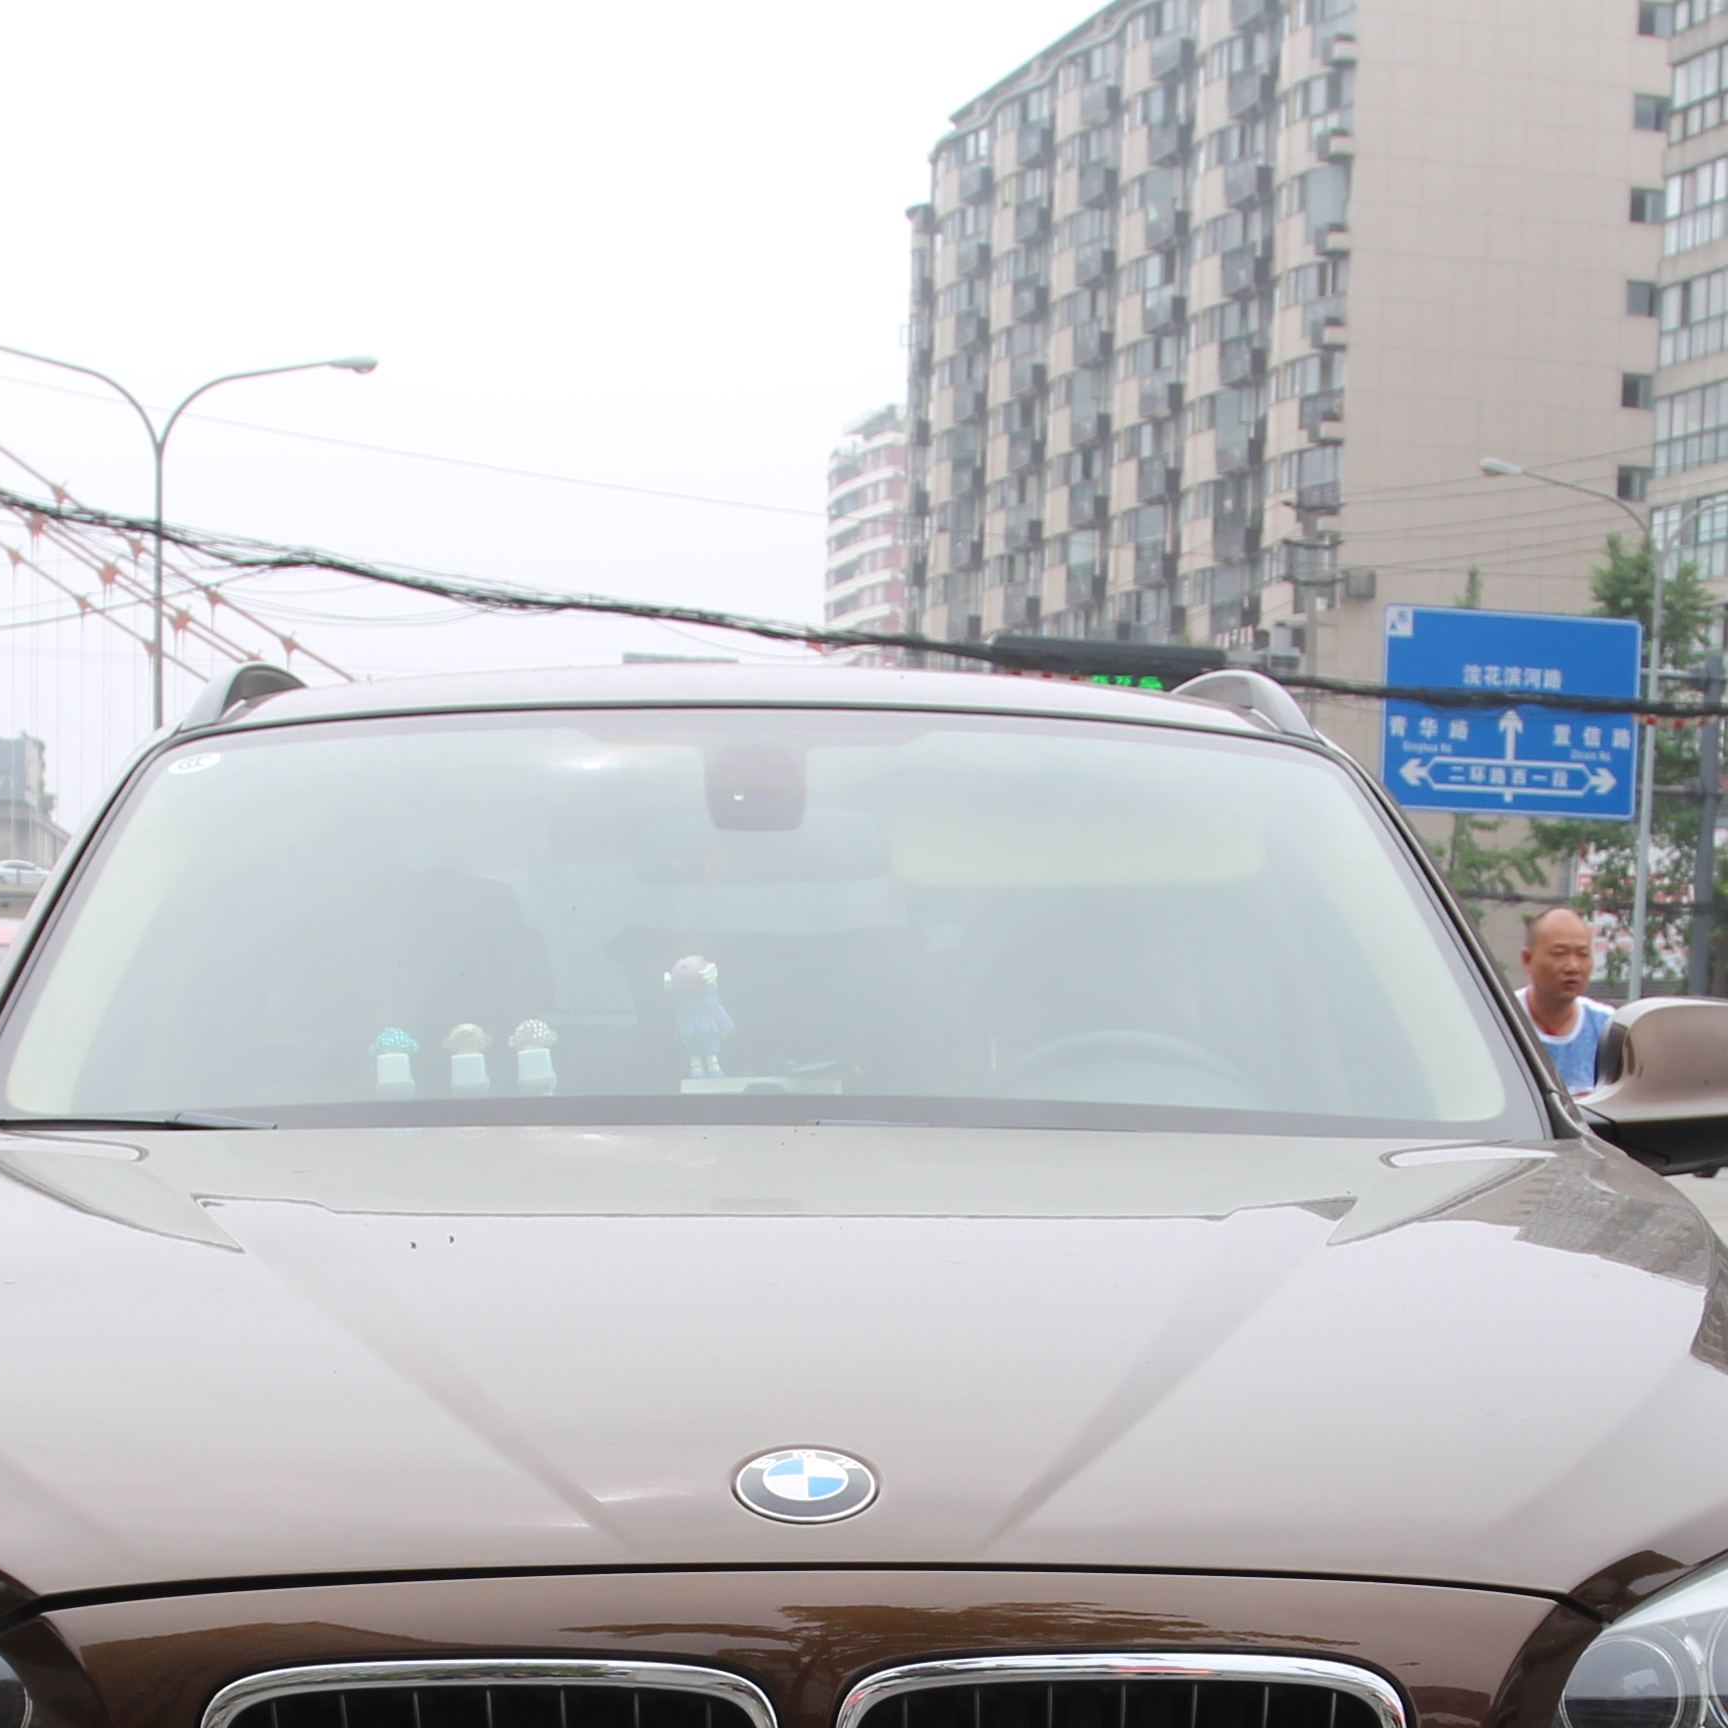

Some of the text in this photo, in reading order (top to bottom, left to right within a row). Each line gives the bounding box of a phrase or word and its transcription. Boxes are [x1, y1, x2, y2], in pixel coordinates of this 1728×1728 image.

[1388, 714, 1469, 741] 青华路
[751, 1450, 860, 1470] BMW
